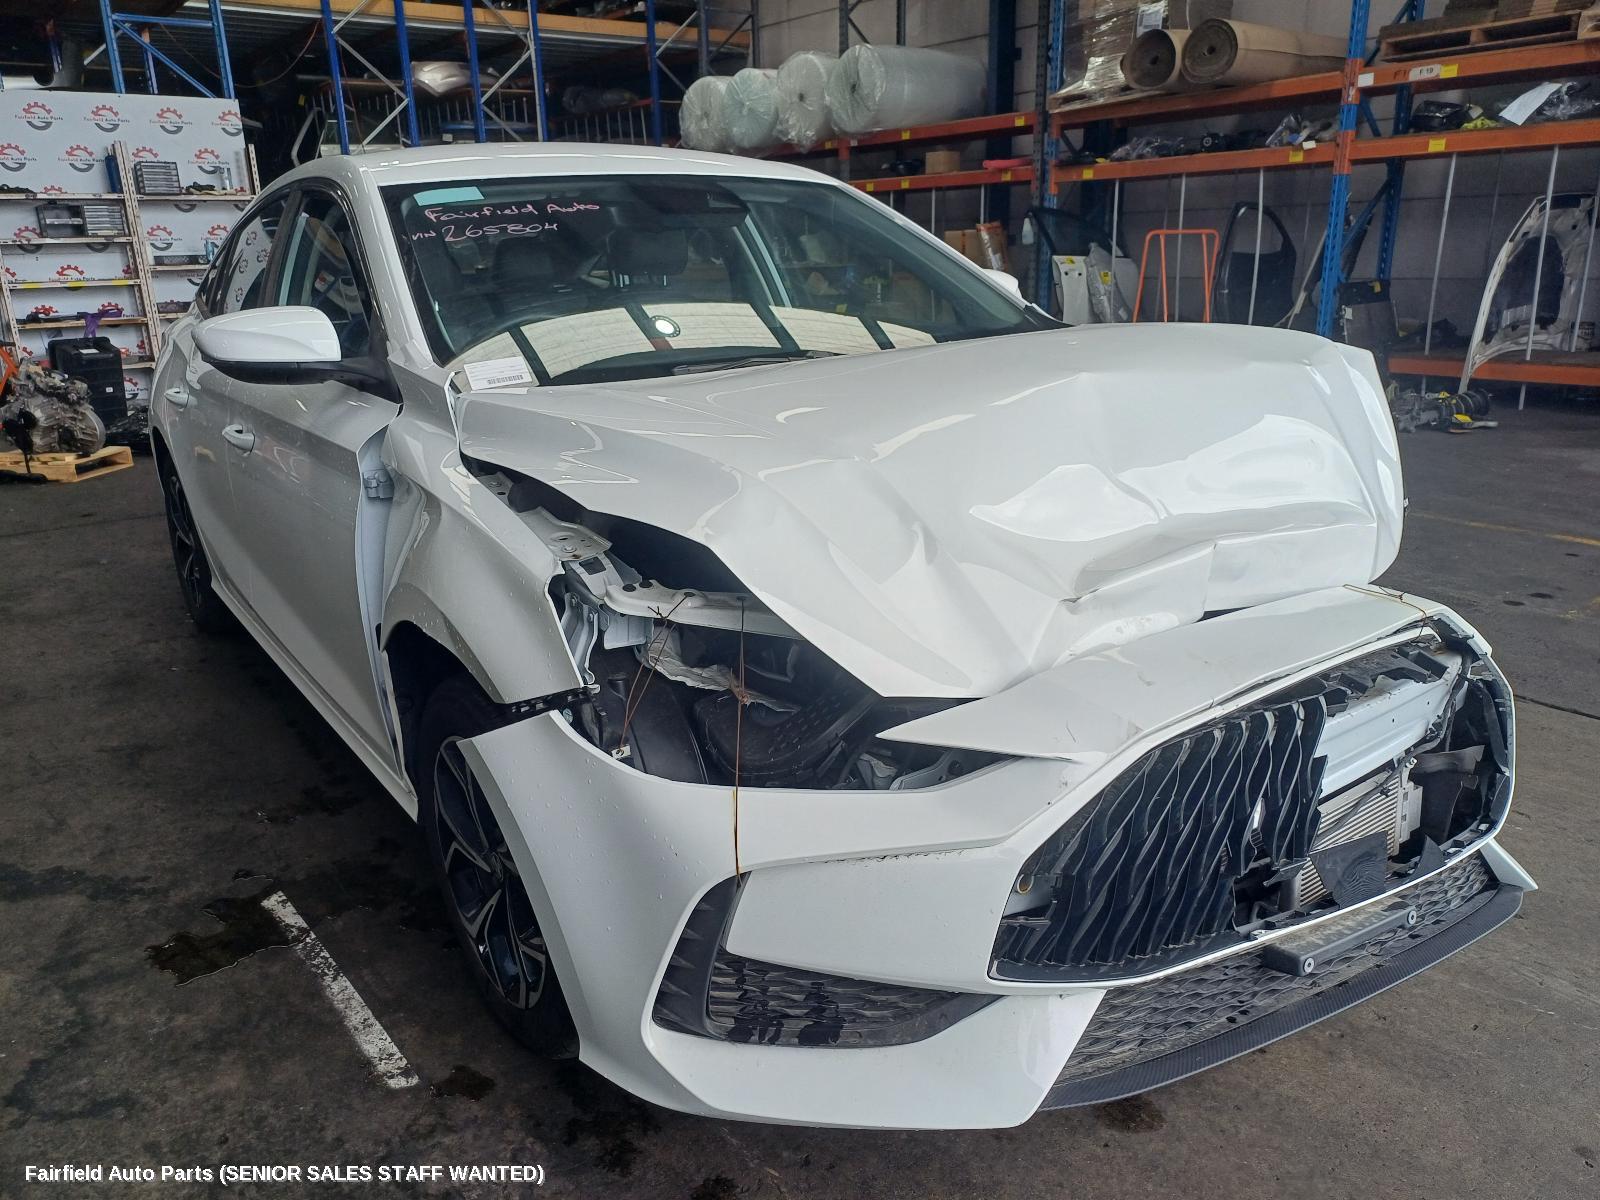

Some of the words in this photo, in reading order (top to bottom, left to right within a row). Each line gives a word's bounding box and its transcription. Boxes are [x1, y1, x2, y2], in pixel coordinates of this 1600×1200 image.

[14, 113, 36, 121] Fairfield
[424, 204, 539, 223] Fairfield
[547, 202, 600, 214] Auto
[441, 222, 558, 242] 265804
